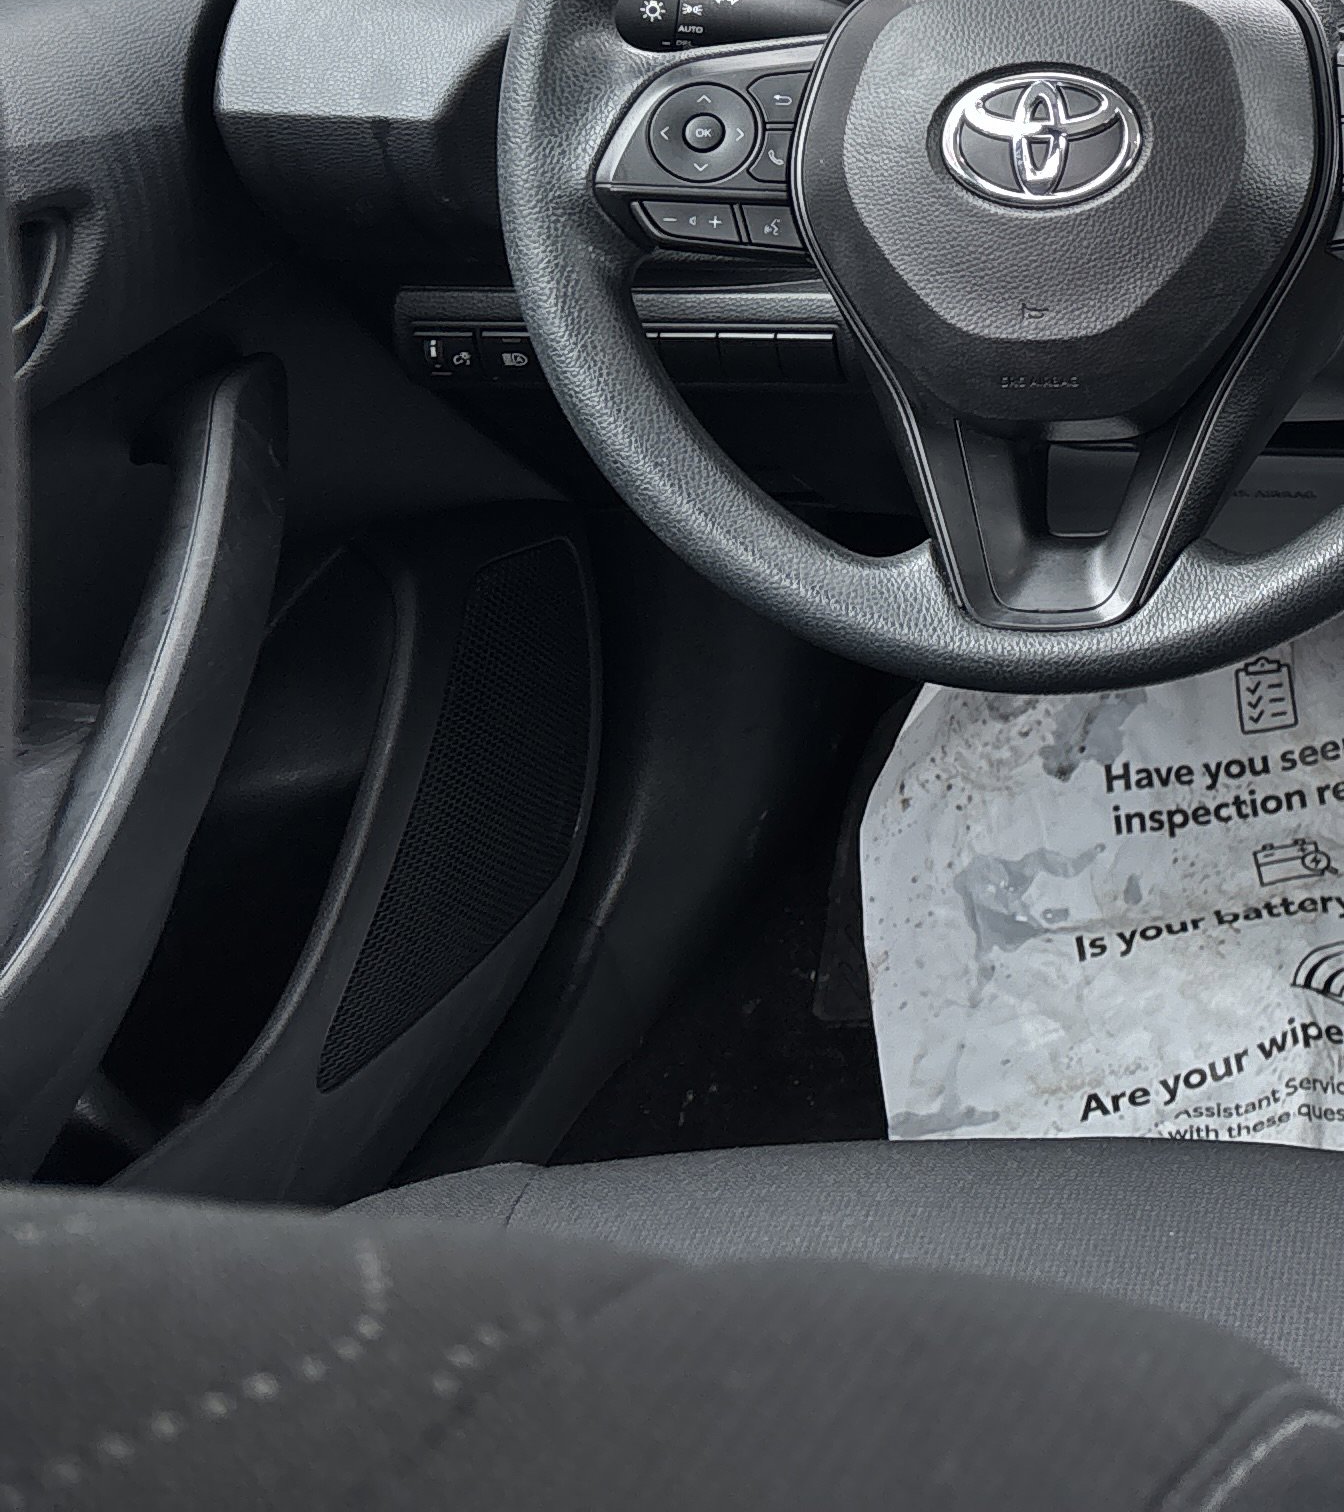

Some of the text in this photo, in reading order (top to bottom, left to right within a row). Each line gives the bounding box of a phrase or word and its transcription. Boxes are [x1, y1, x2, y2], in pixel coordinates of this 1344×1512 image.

[677, 25, 704, 34] AUTO
[695, 128, 713, 138] OK
[1103, 760, 1196, 794] Have
[1202, 756, 1272, 791] you
[1111, 786, 1309, 839] inspection
[1075, 932, 1108, 962] Is
[1117, 915, 1206, 955] your
[1079, 1086, 1151, 1122] Are
[1159, 1047, 1250, 1104] your
[1226, 1111, 1292, 1139] these
